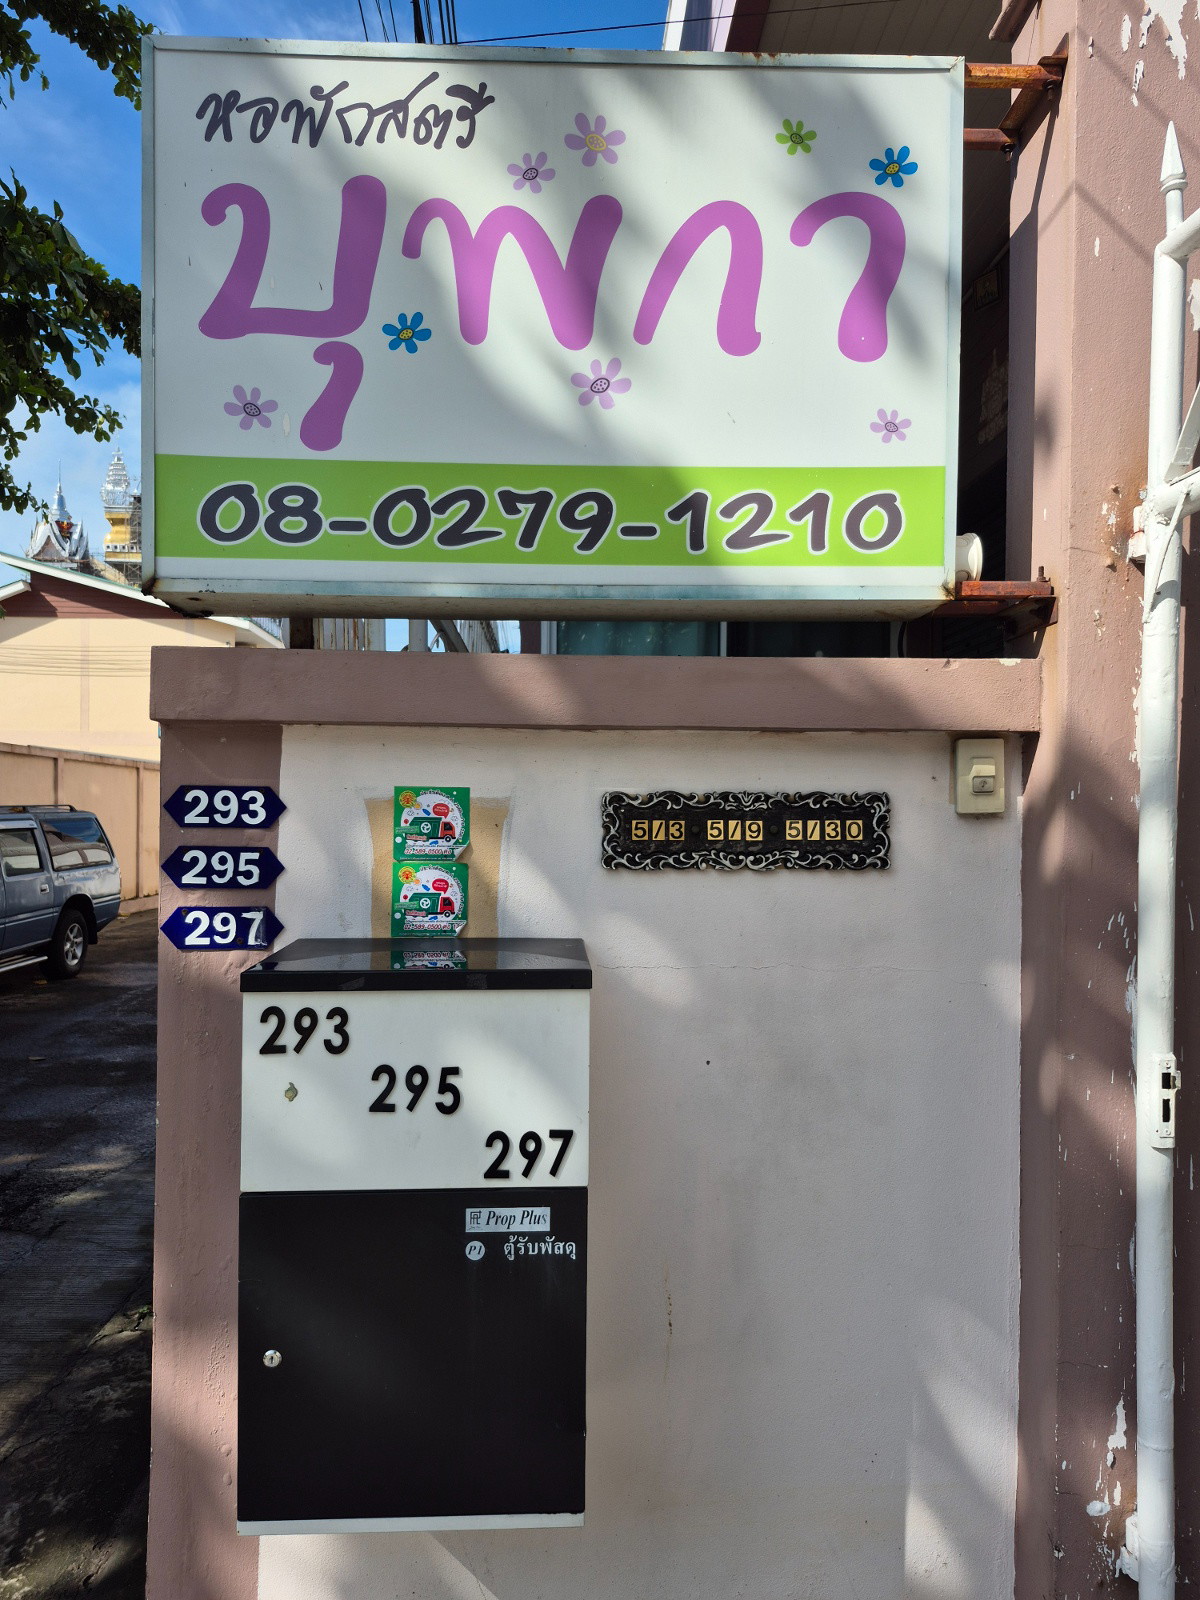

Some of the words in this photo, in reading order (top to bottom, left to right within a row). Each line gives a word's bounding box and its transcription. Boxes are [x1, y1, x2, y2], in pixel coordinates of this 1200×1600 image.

[196, 71, 496, 150] หอพักสตรี
[198, 481, 904, 556] 08-0279-1210
[184, 789, 267, 825] 293
[633, 821, 684, 840] 5/3
[706, 821, 762, 840] 5/9
[787, 821, 863, 840] 5/30
[182, 850, 261, 886] 295
[184, 910, 268, 946] 297
[259, 1006, 349, 1055] 293
[369, 1064, 461, 1115] 295
[483, 1130, 574, 1179] 297
[485, 1210, 516, 1230] Prop
[520, 1209, 548, 1226] Plus
[503, 1235, 576, 1260] ตู้รับพัสดุ
